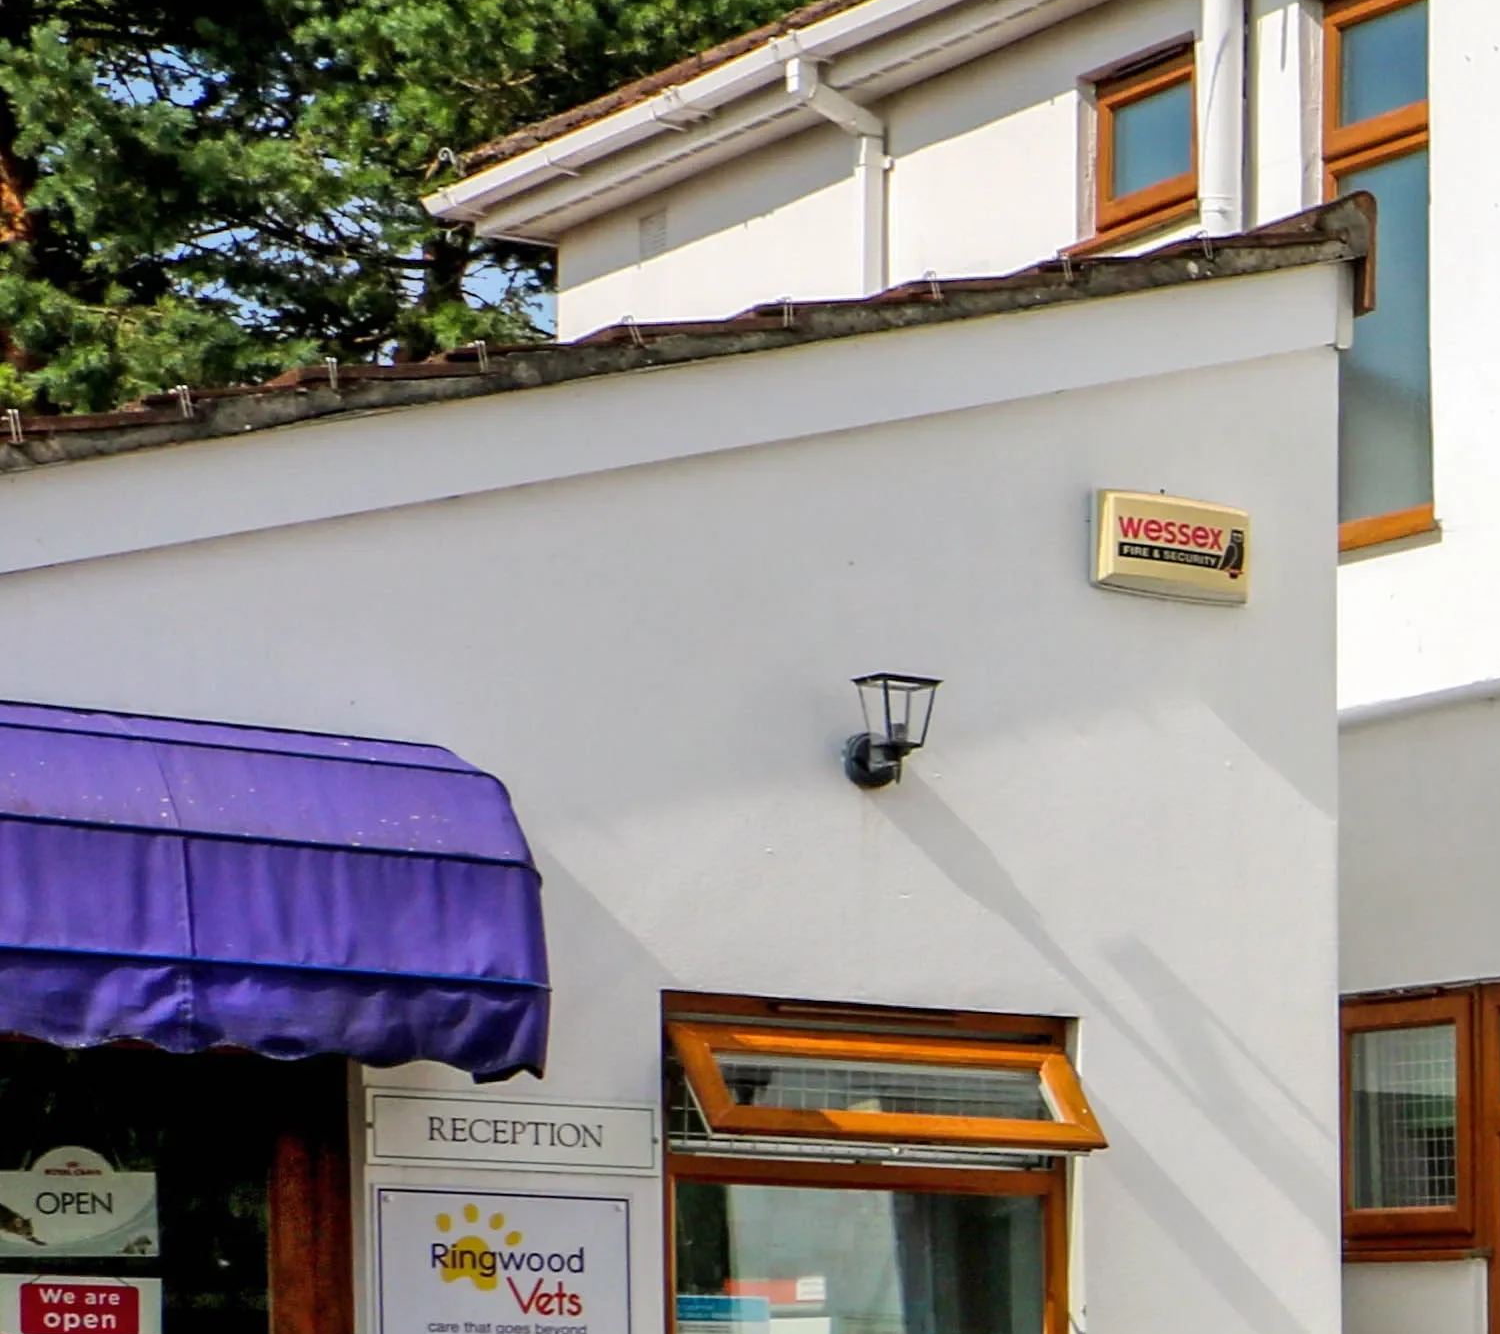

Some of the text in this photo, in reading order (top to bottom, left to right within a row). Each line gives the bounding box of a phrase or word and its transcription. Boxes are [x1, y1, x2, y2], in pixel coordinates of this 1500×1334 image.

[1118, 515, 1224, 552] wessex
[1122, 545, 1217, 566] FIRE & SECURITY
[427, 1116, 603, 1148] RECEPTION
[36, 1191, 113, 1215] OPEN
[431, 1243, 584, 1278] Ringwood
[39, 1288, 120, 1306] We are
[506, 1276, 583, 1316] Vets
[43, 1312, 117, 1332] open
[428, 1323, 460, 1334] care
[464, 1321, 492, 1334] that
